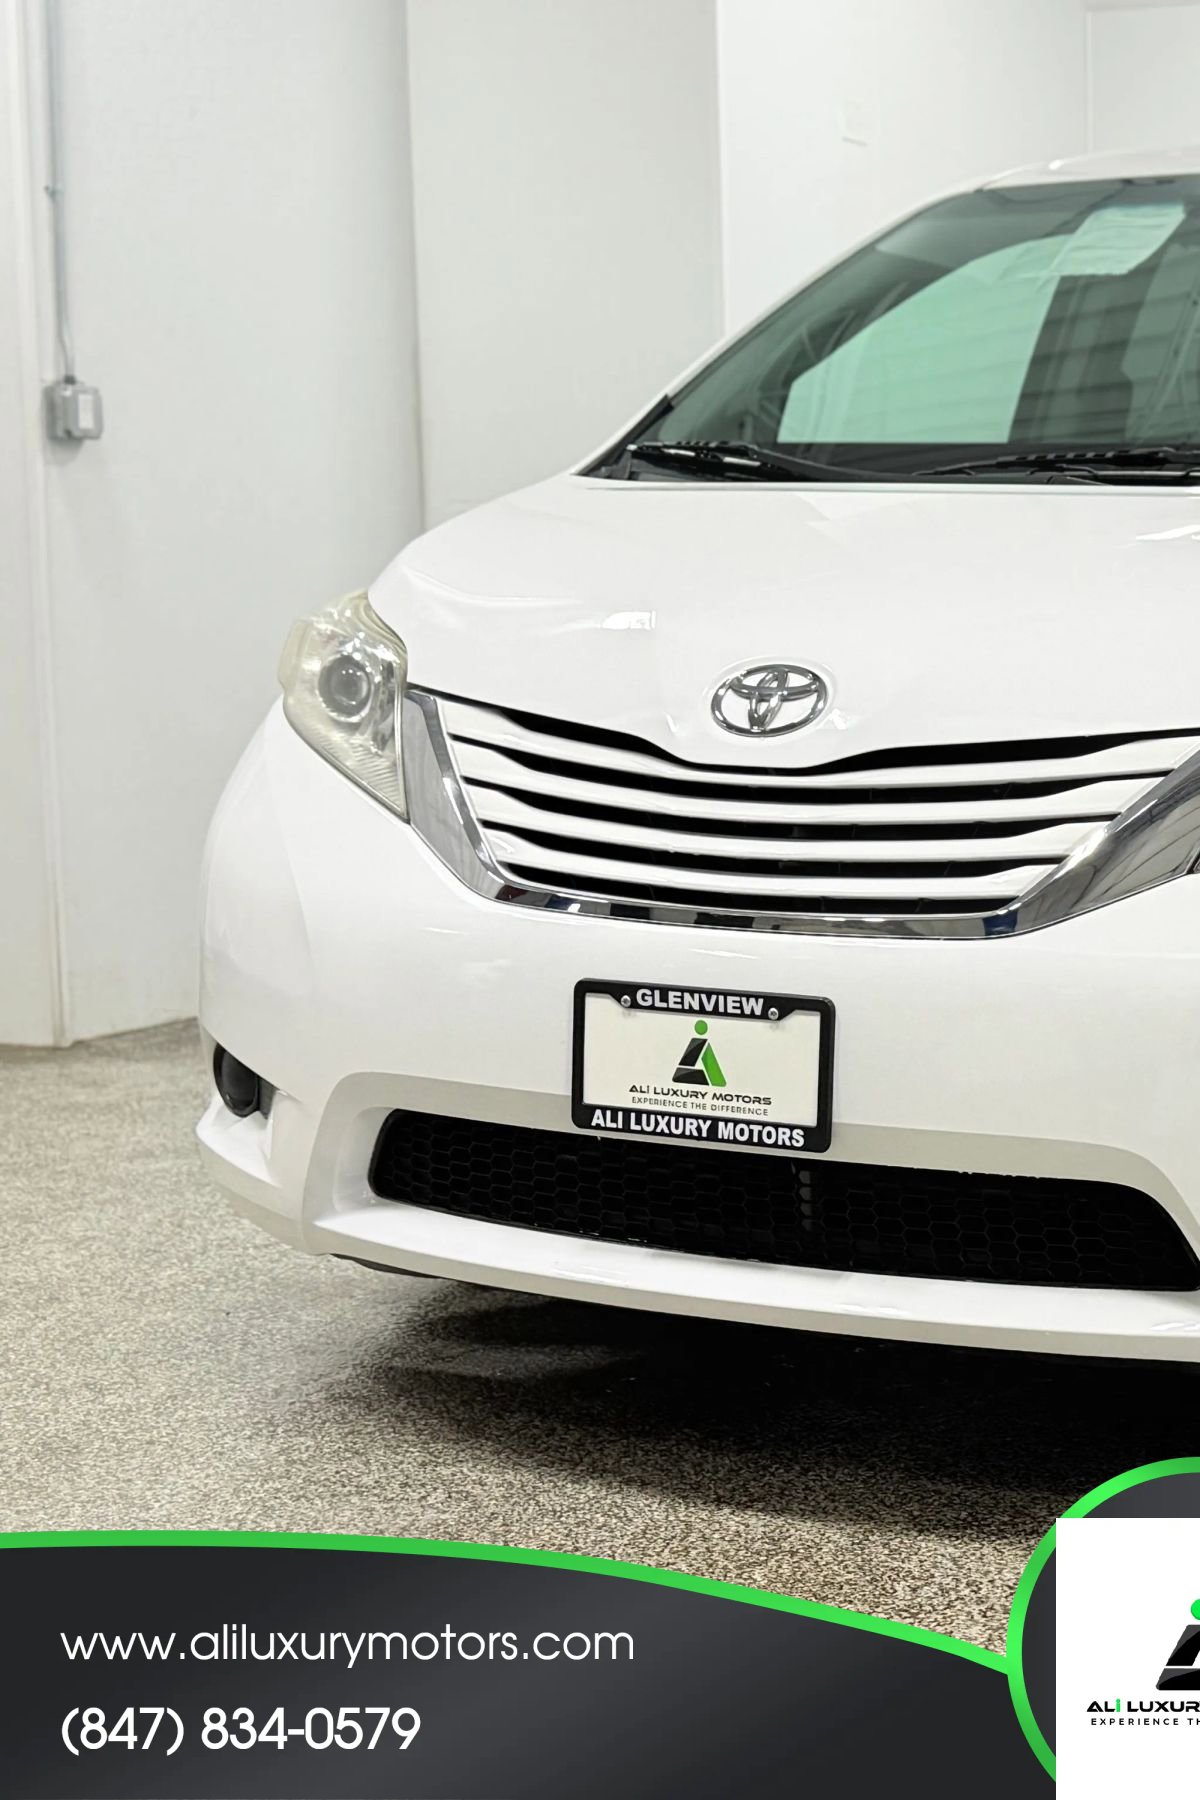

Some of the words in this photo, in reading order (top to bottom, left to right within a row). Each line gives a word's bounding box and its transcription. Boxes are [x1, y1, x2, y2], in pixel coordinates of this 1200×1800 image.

[636, 988, 764, 1016] GLENVIEW
[631, 1096, 687, 1109] EXPERIENCE
[690, 1102, 707, 1111] THE
[711, 1104, 768, 1116] DIFFERENCE
[653, 1086, 708, 1100] LUXURY
[711, 1092, 772, 1106] MOTORS
[591, 1109, 623, 1129] ALI
[630, 1112, 711, 1138] LUXURY
[717, 1124, 805, 1148] MOTORS
